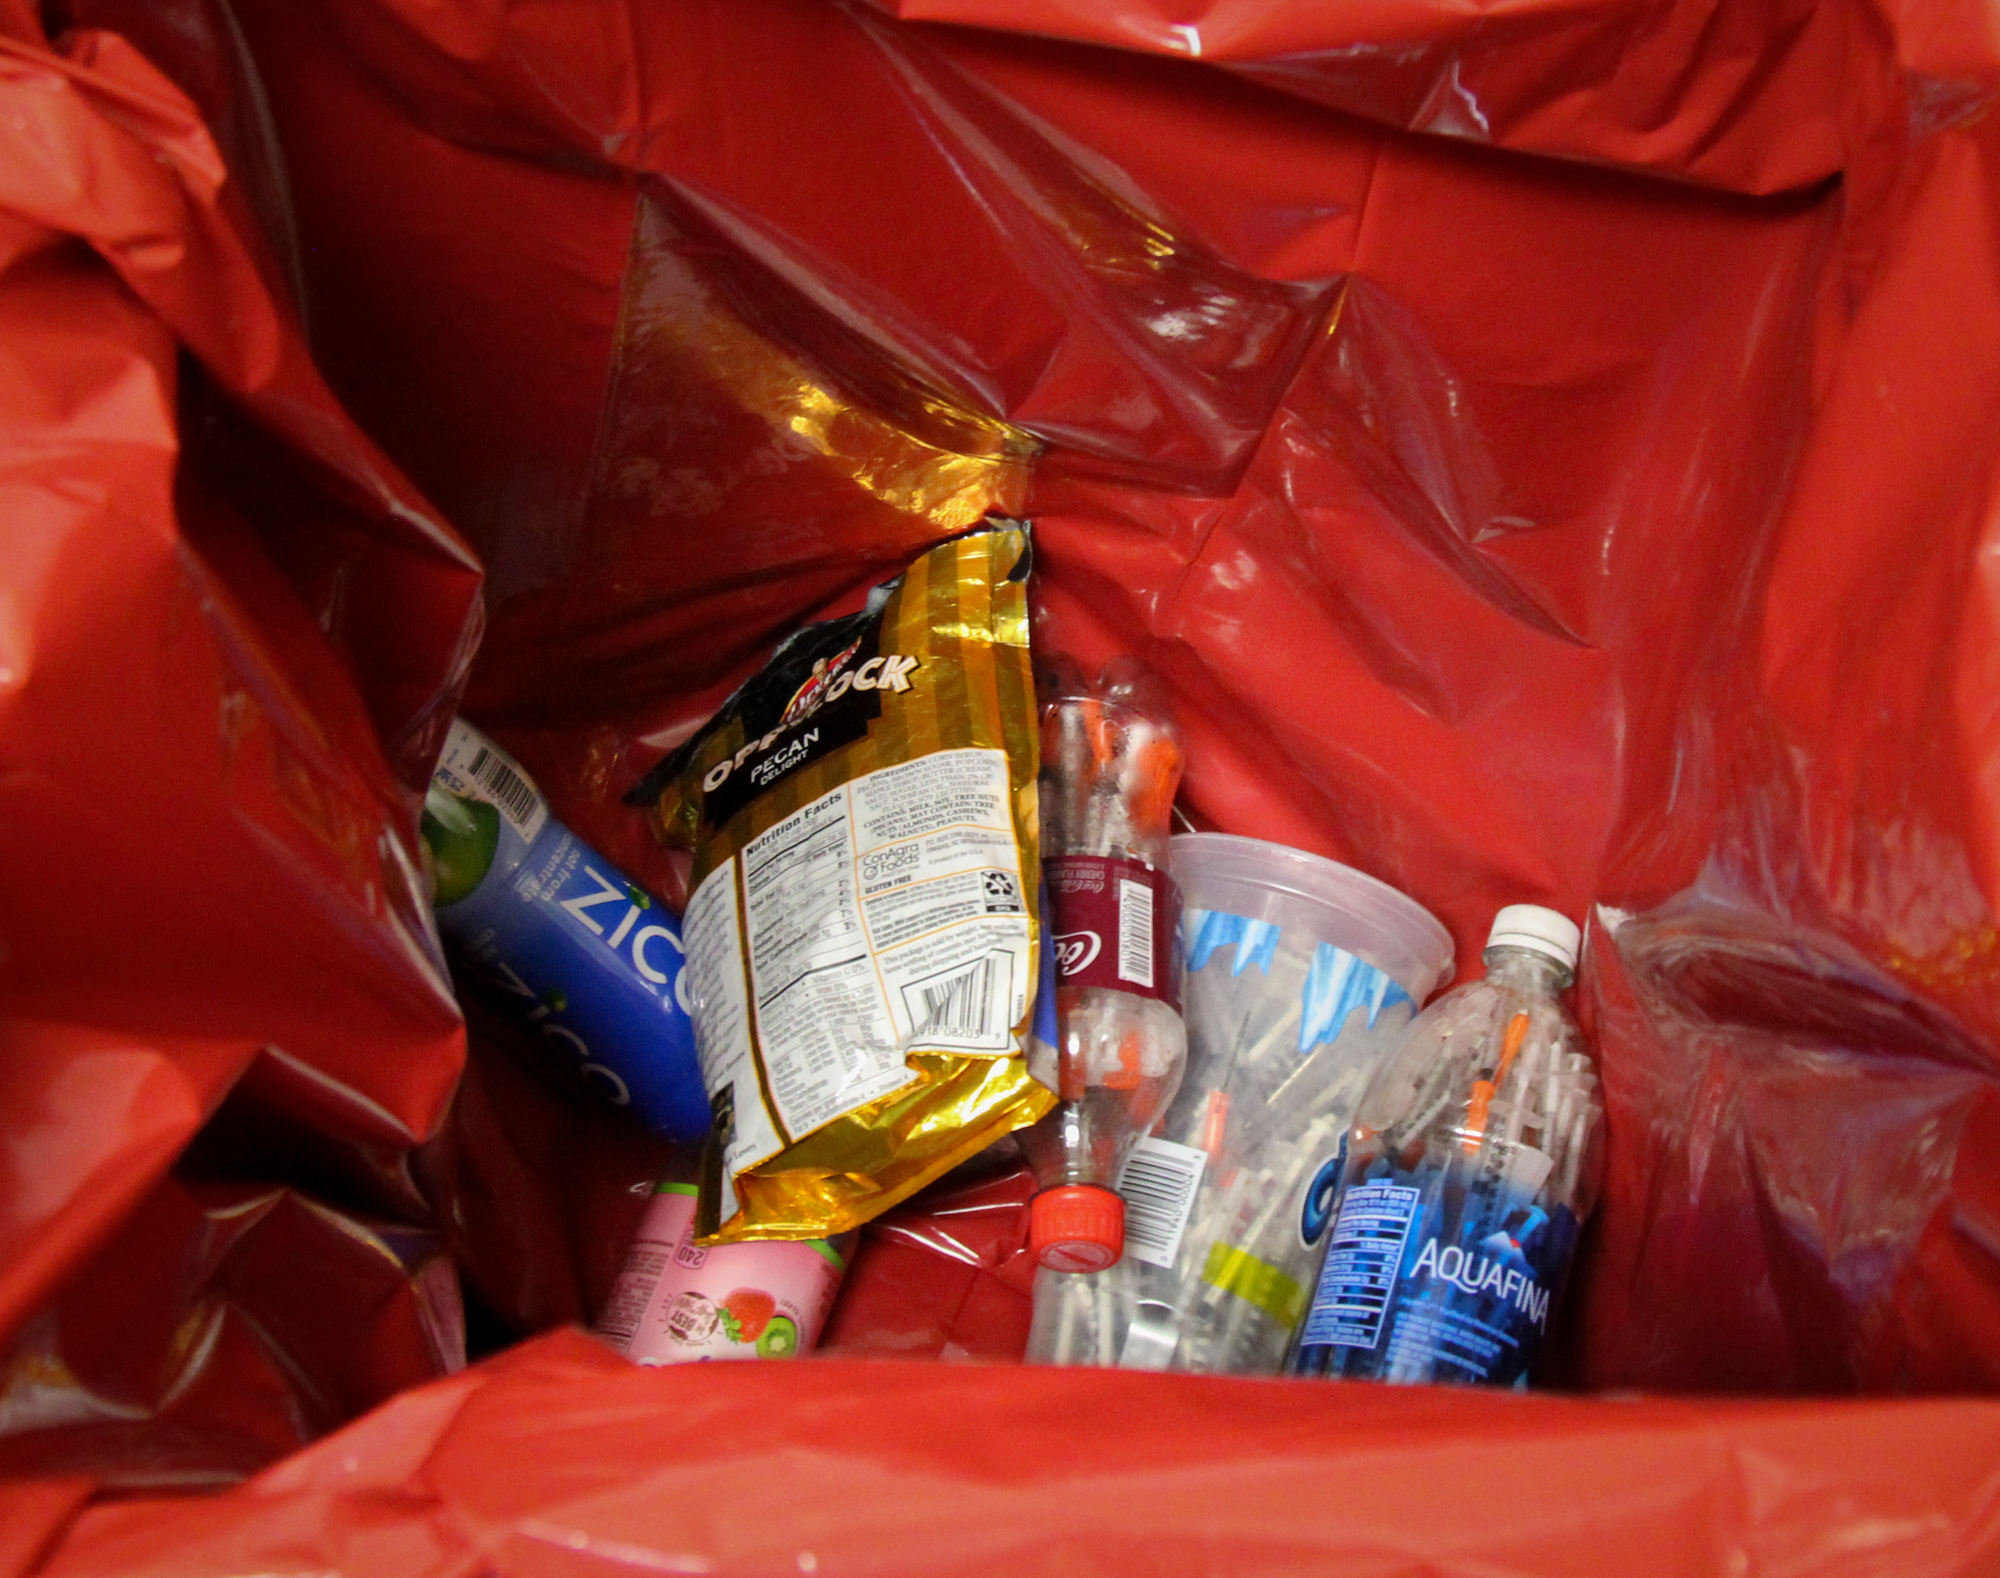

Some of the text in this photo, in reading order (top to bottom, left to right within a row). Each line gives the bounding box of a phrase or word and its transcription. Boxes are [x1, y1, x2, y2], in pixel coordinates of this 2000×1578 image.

[751, 727, 820, 783] PECAN
[760, 750, 809, 786] DELIGHT
[955, 794, 976, 802] TREE
[978, 793, 1000, 803] NUTS
[974, 800, 995, 809] TREE
[746, 816, 801, 857] Nutrition
[804, 792, 843, 819] Facts
[863, 843, 919, 866] ConAgra
[880, 853, 920, 873] Foods
[539, 848, 582, 902] not from
[865, 874, 912, 895] GLUTEN FREE
[1122, 897, 1132, 928] 49000
[1383, 1189, 1414, 1201] Facts
[676, 1245, 705, 1266] 240
[1409, 1237, 1550, 1337] AQUAFINA
